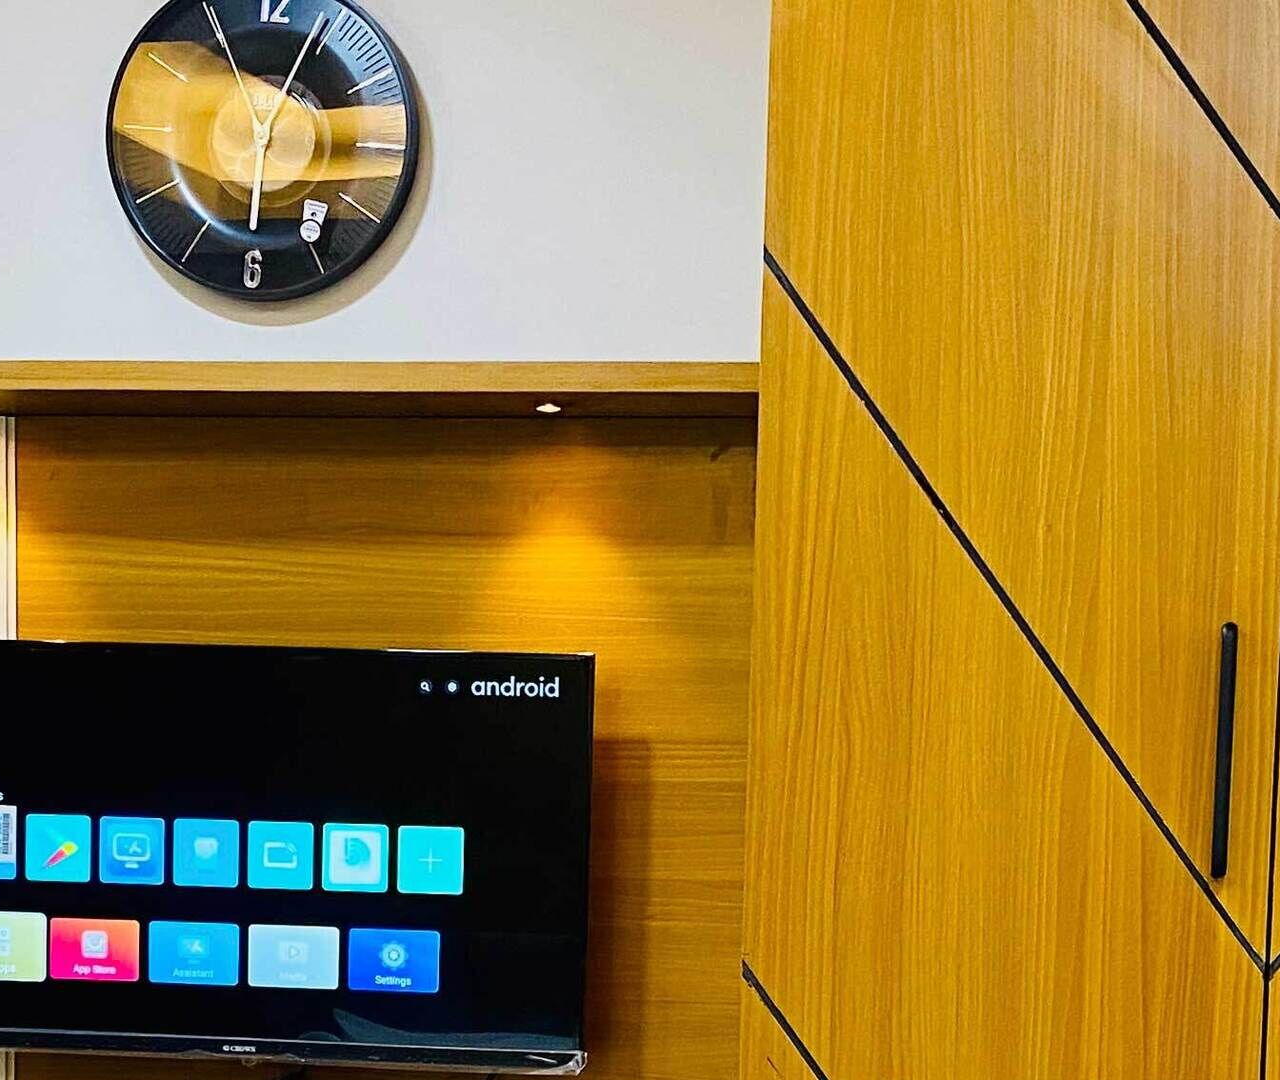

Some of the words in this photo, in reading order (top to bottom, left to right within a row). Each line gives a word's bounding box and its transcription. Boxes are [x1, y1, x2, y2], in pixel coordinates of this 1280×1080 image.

[260, 0, 290, 24] 12
[243, 249, 263, 289] 6
[470, 675, 560, 698] android
[72, 963, 91, 975] App
[92, 965, 117, 975] Store
[374, 975, 413, 988] Settings
